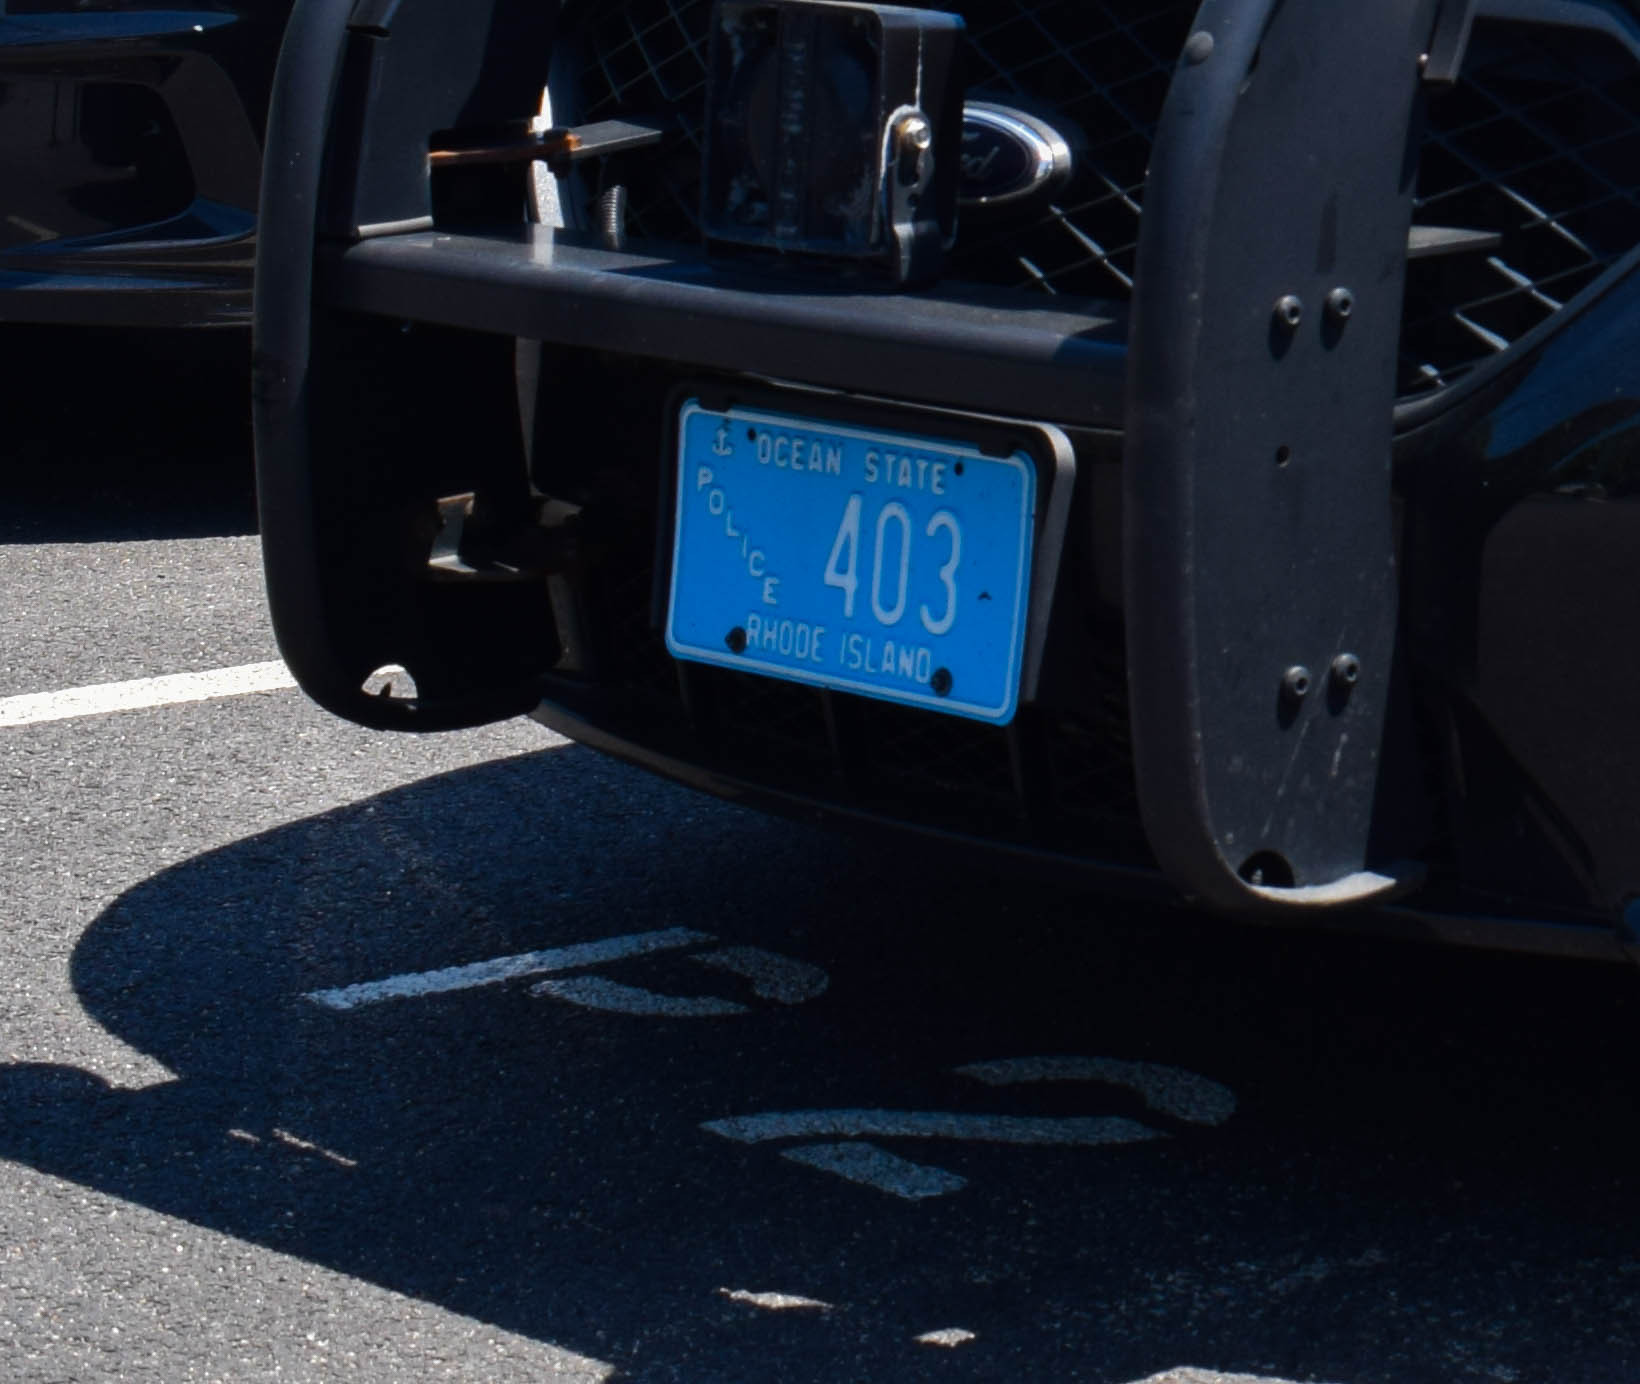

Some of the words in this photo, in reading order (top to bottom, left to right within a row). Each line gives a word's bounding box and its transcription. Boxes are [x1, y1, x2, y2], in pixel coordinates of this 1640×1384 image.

[756, 432, 842, 476] OCEAN
[863, 450, 948, 495] STATE
[696, 465, 781, 605] POLICE
[823, 492, 963, 637] 403
[744, 613, 826, 663] RHODE
[839, 633, 932, 685] ISLAND
